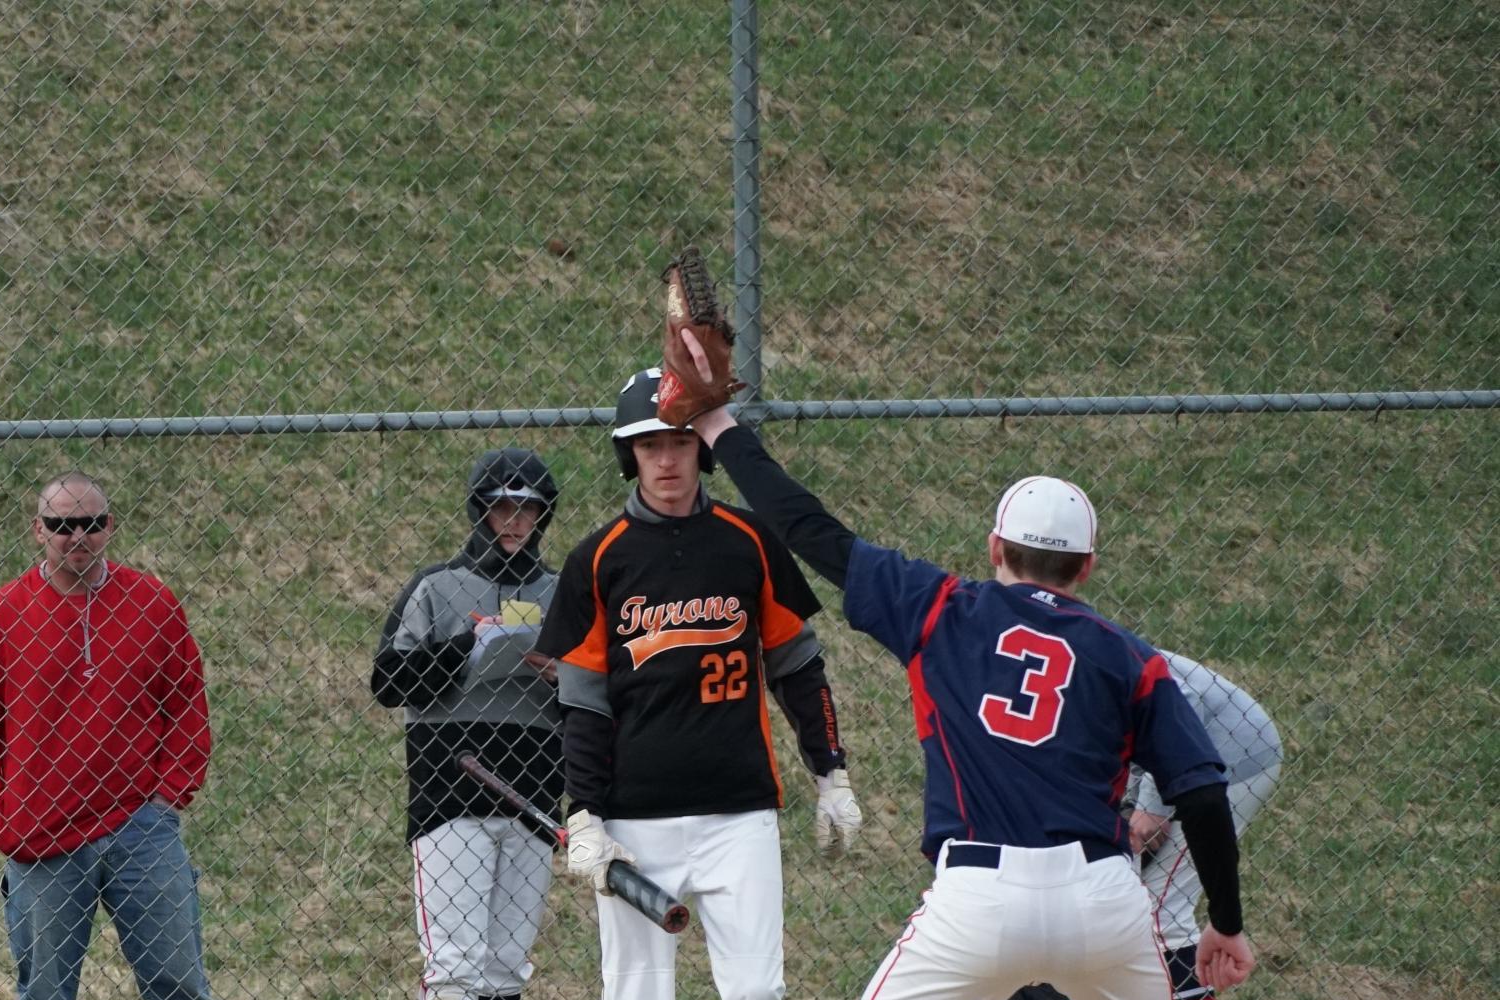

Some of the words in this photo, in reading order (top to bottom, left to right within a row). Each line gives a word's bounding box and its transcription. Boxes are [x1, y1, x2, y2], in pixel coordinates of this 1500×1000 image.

[1023, 533, 1068, 547] BEARCATS
[617, 595, 742, 641] Tyrone
[701, 650, 747, 704] 22
[978, 625, 1076, 747] 3
